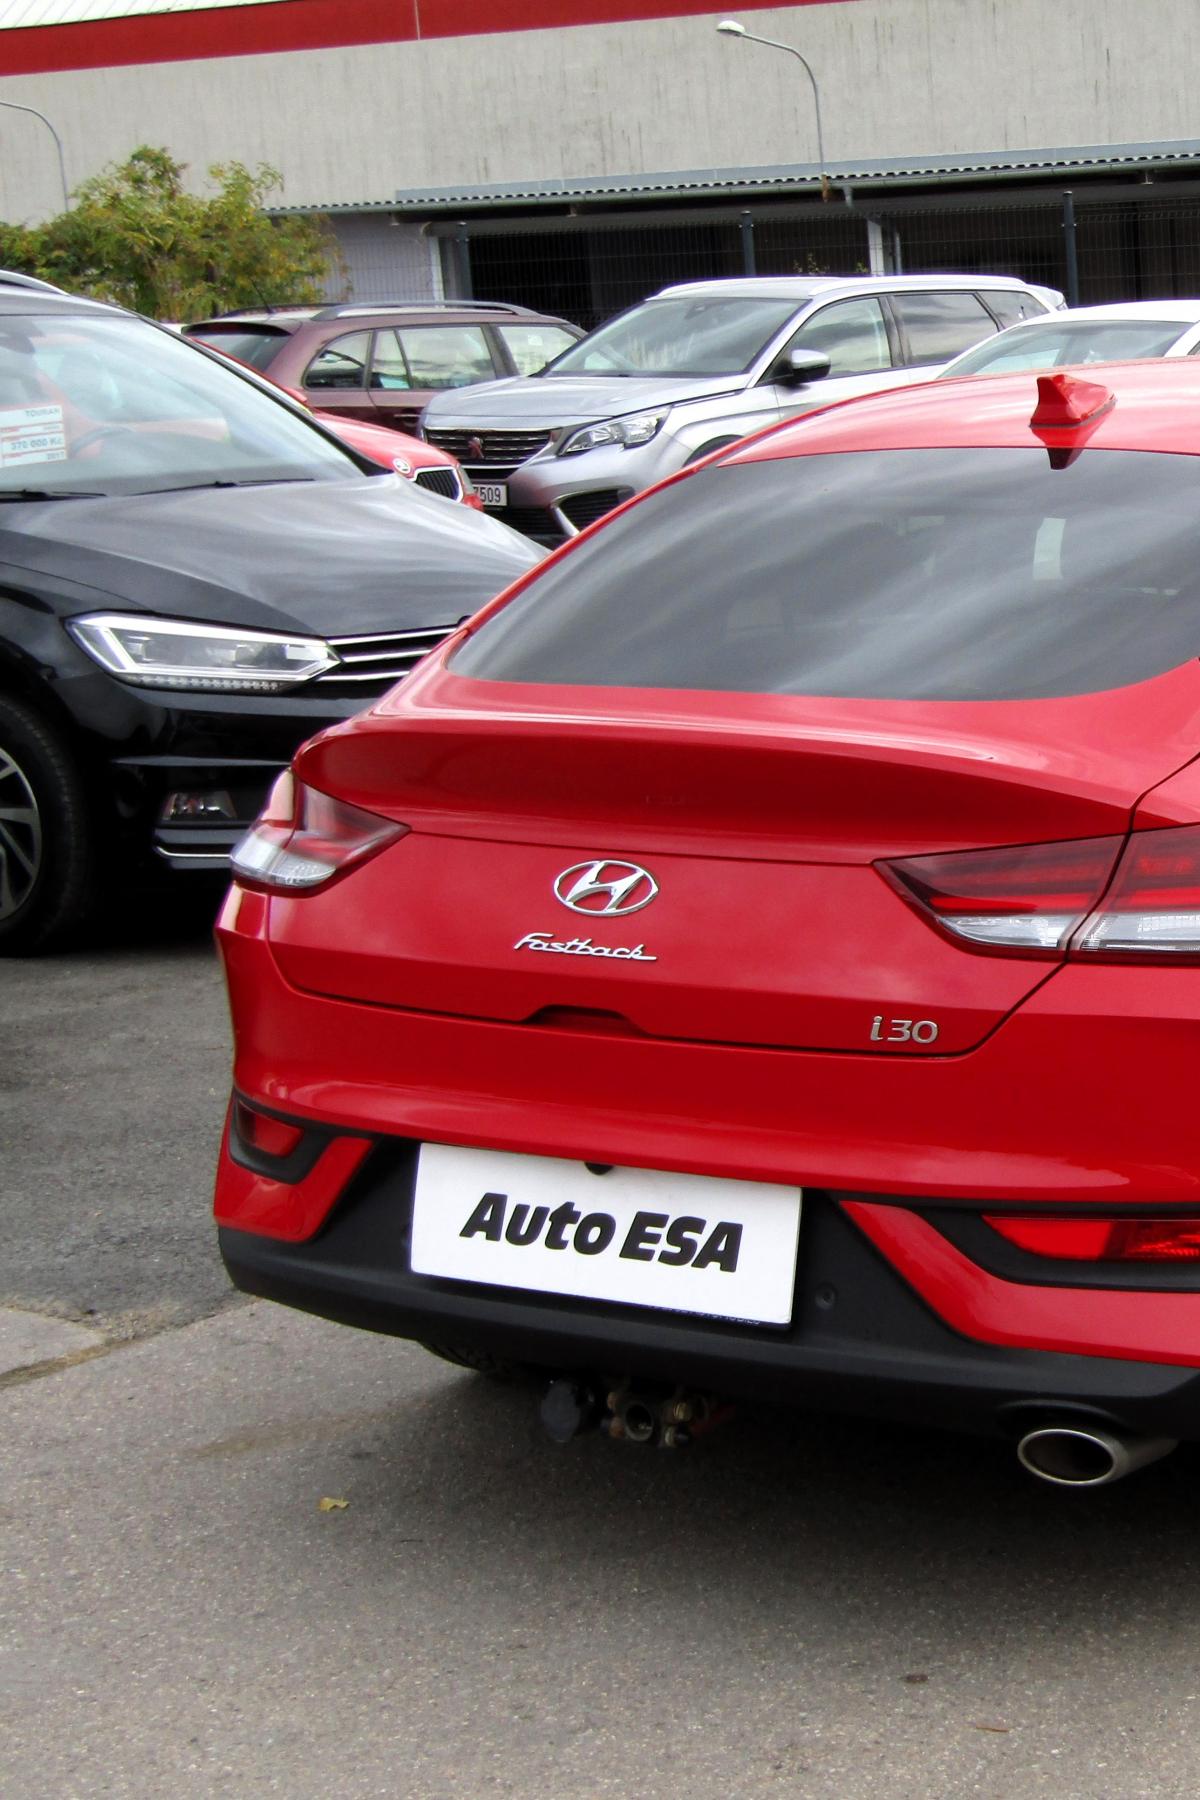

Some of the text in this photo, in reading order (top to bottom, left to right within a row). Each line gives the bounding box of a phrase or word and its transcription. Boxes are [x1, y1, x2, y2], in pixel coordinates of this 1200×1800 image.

[513, 932, 657, 961] Fastback
[870, 1015, 939, 1044] i30
[459, 1191, 744, 1273] Auto ESA
